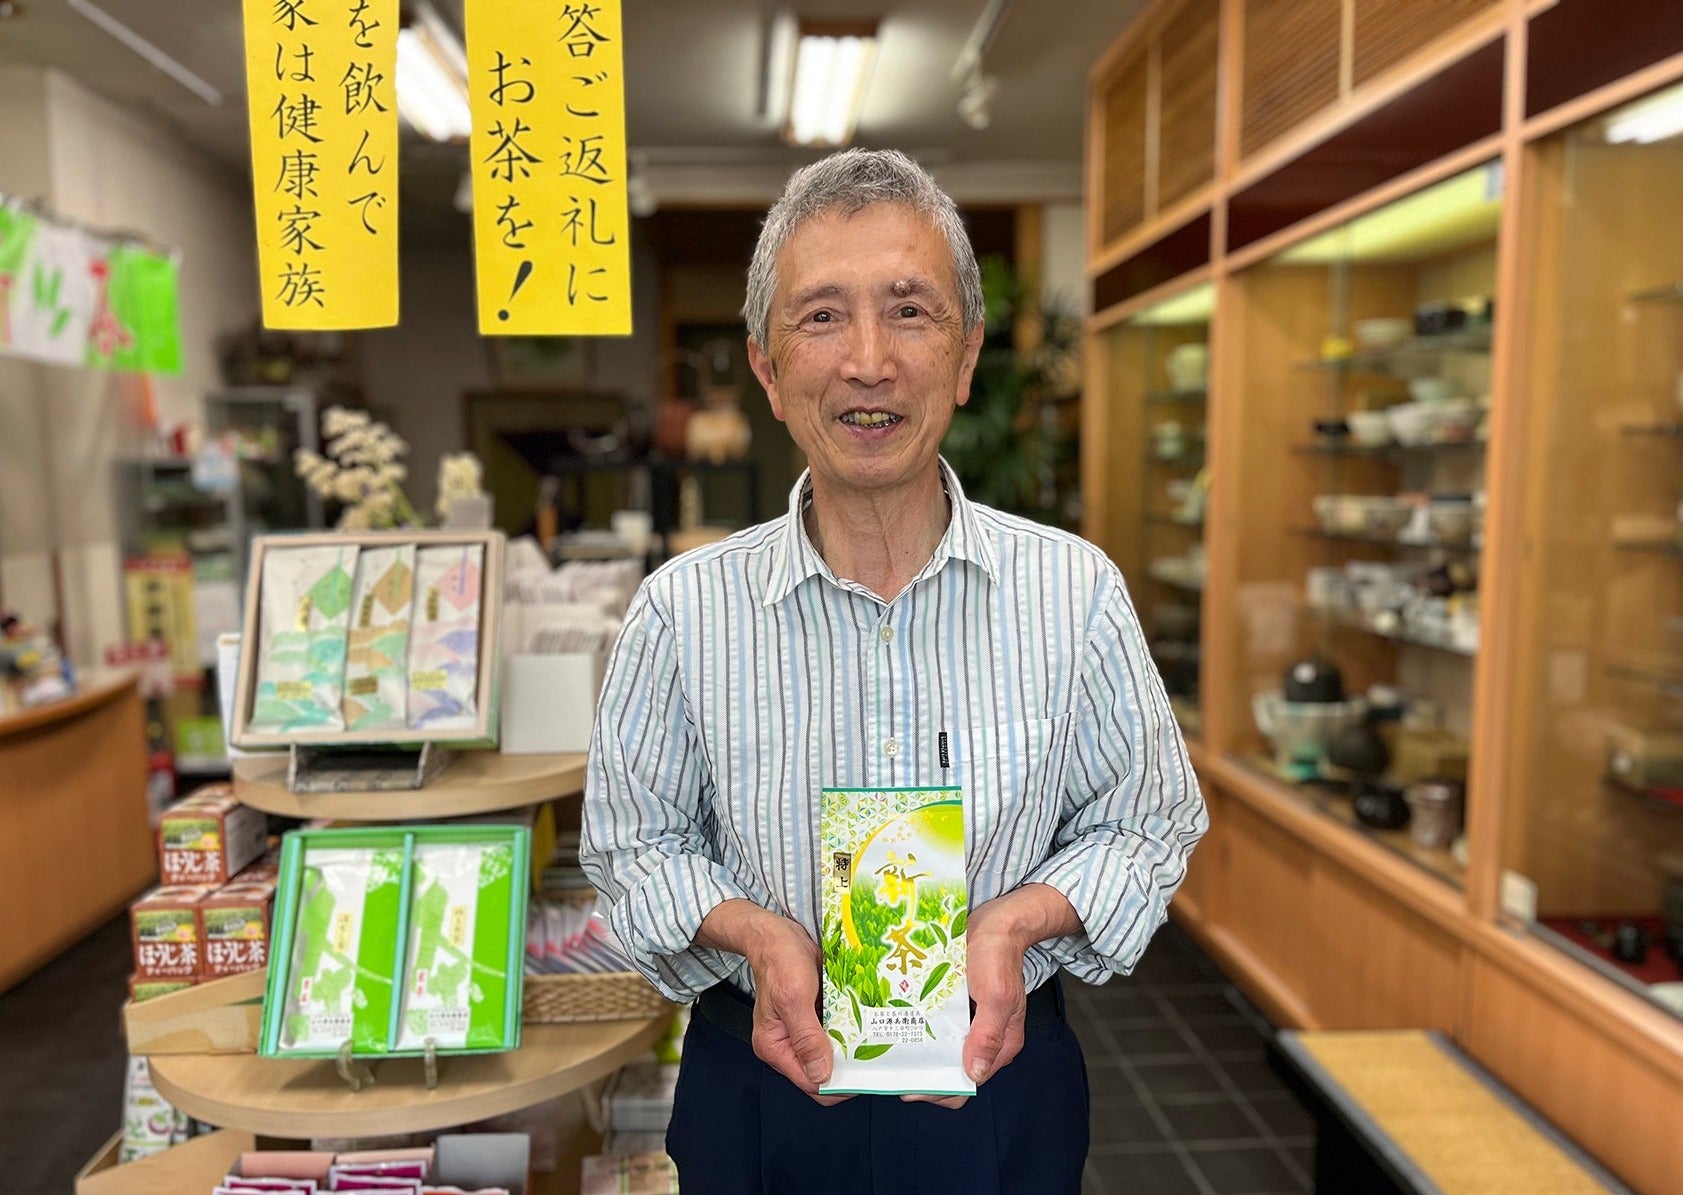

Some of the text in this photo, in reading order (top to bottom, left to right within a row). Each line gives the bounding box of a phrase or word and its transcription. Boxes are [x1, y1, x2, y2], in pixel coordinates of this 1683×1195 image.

[338, 0, 388, 235] を飲んで
[557, 4, 615, 305] 答ご返礼に
[483, 50, 543, 321] お茶を!
[164, 852, 220, 873] ほうじ茶
[836, 857, 850, 888] 特上
[207, 940, 265, 964] ほうじ茶
[875, 851, 932, 976] 新茶
[139, 942, 197, 966] ほうじ茶
